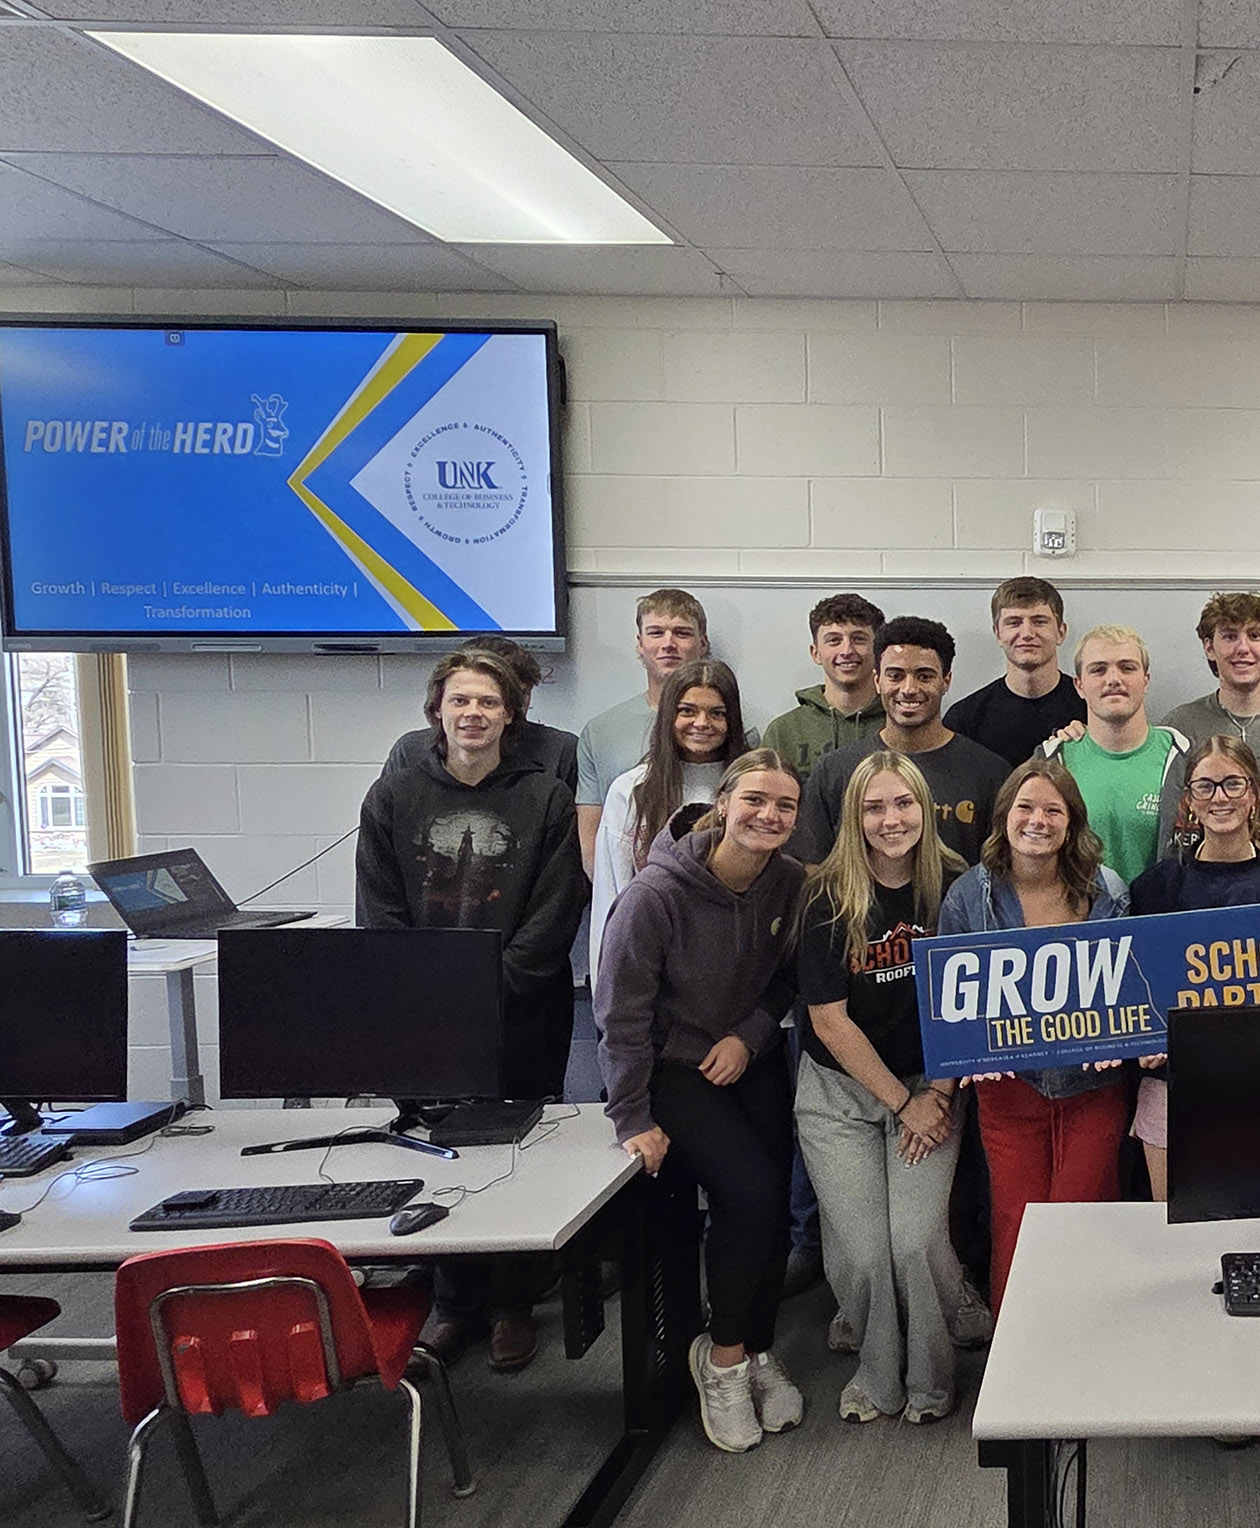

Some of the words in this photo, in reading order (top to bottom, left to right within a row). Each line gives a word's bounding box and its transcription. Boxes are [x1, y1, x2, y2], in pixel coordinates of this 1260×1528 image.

[24, 420, 129, 453] POWER
[130, 422, 147, 451] of
[148, 422, 171, 451] the
[173, 422, 255, 454] HERD
[410, 422, 459, 458] EXCELLENCE
[473, 423, 526, 472] AUTHENTICITY
[404, 470, 418, 512] RESPECT
[435, 461, 499, 489] UNK
[422, 492, 459, 501] COLLEGE
[461, 493, 472, 501] OF
[474, 492, 514, 501] BUSINESS
[436, 501, 443, 509] &
[444, 501, 501, 510] TECHNOLOGY
[473, 485, 529, 545] TRANSFORMATION
[424, 521, 461, 544] GROWTH
[31, 582, 86, 596] Growth
[101, 582, 157, 599] Respect
[173, 582, 247, 596] Excellence
[262, 582, 348, 600] Authenticity
[144, 604, 252, 619] Transformation
[940, 935, 1133, 1024] GROW
[990, 1016, 1034, 1047] THE
[1041, 1009, 1101, 1043] GOOD
[1108, 1004, 1152, 1036] LIFE
